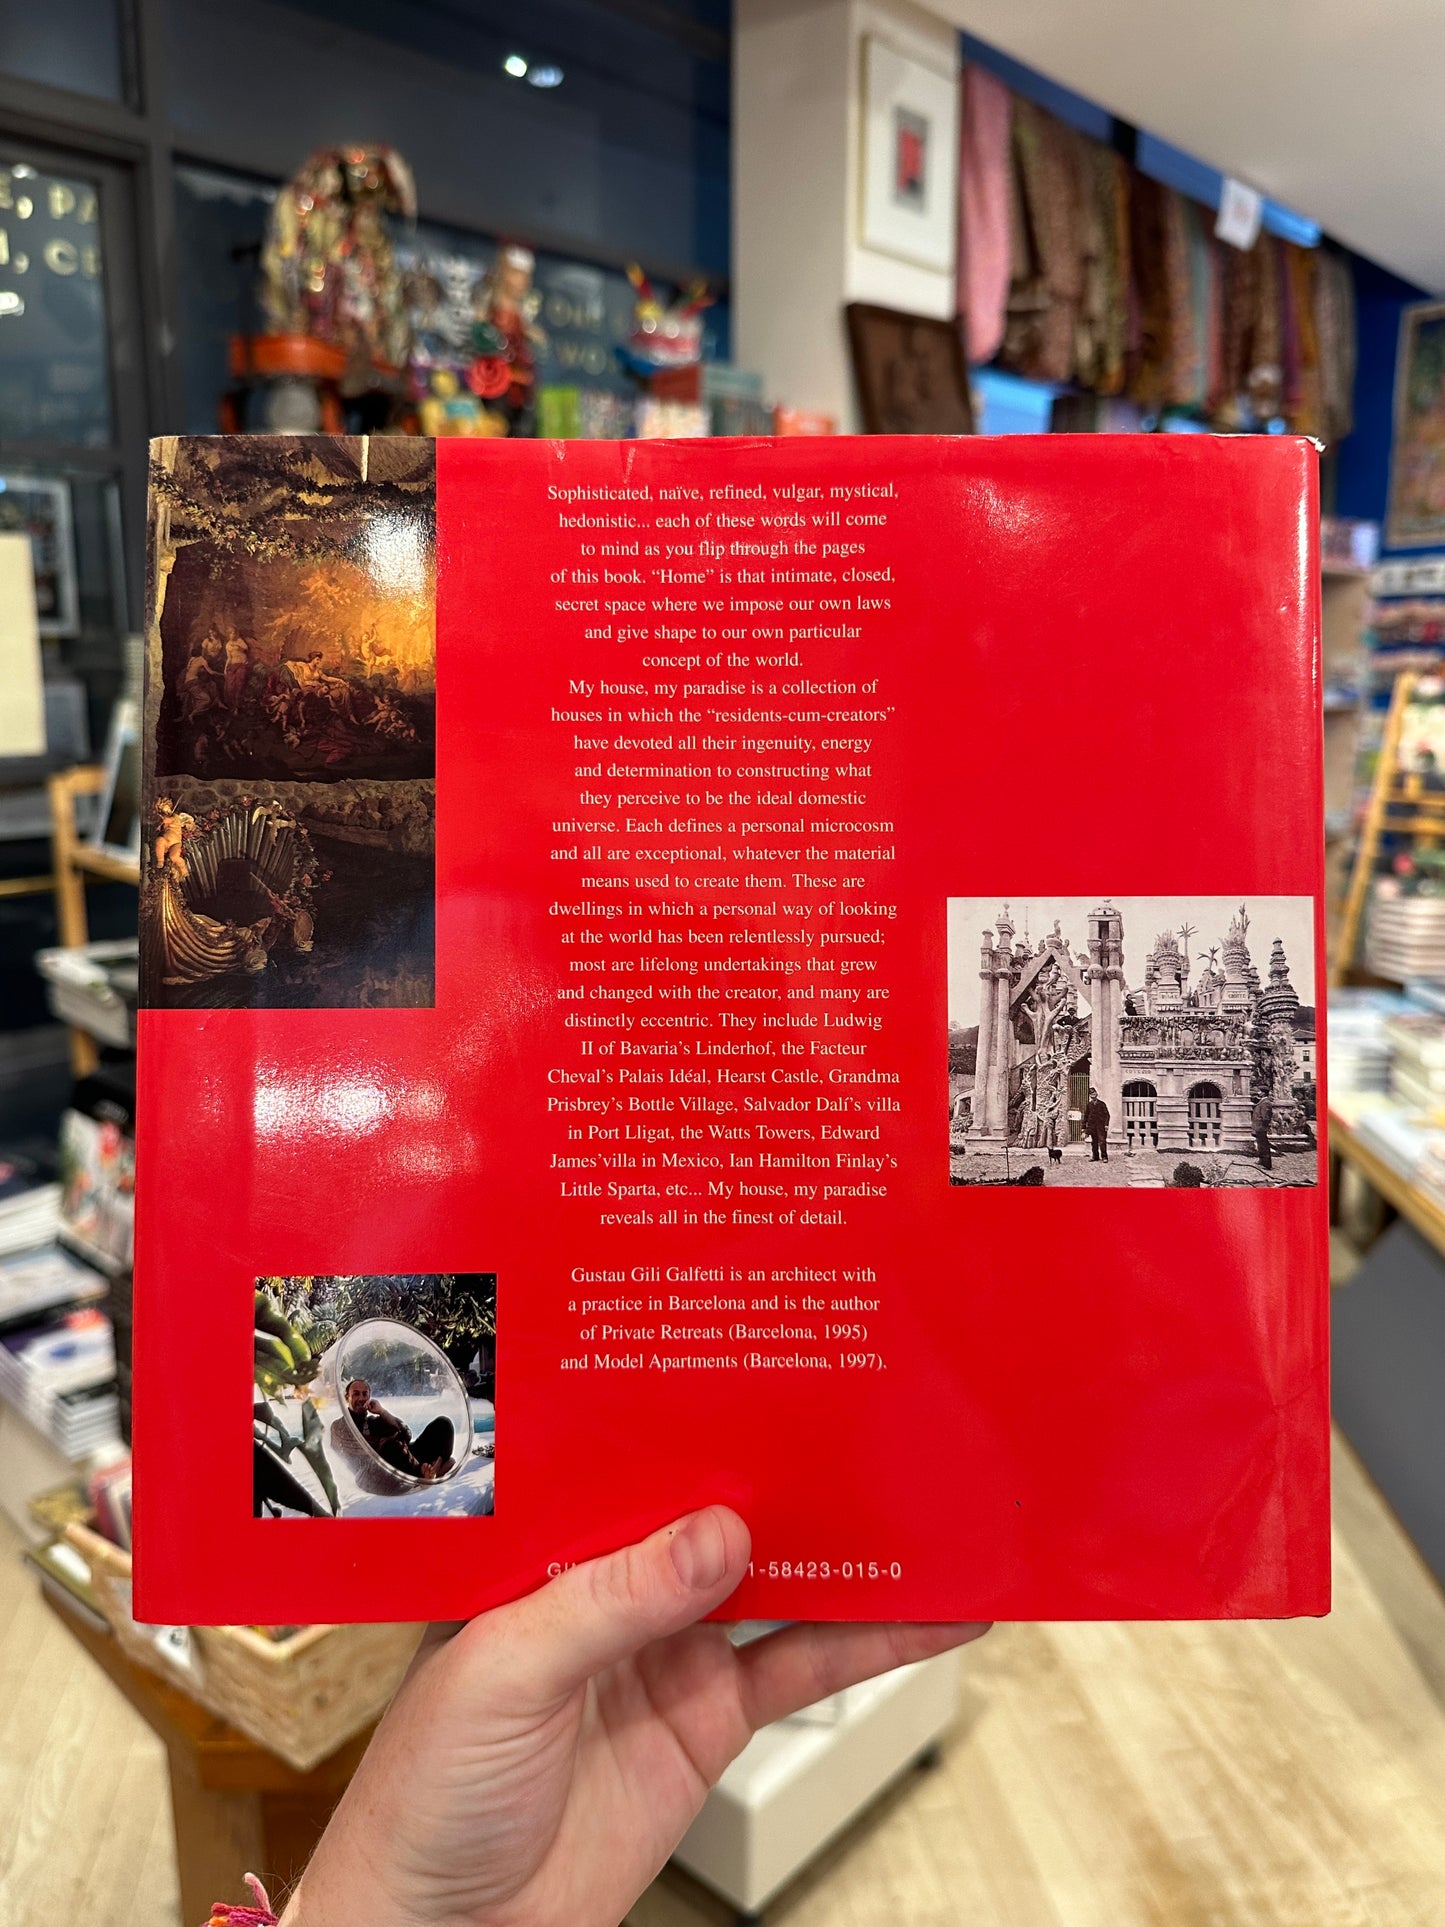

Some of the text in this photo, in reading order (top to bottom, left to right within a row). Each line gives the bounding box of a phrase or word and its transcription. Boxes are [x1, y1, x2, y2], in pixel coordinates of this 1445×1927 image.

[547, 481, 899, 503] Sophisticated, naïve, refined, vulgar, mystical,
[558, 510, 888, 529] hedonistic... each of these words will come
[549, 566, 896, 585] of this book. “Home” is that intimate, closed,
[554, 594, 892, 616] secret space where we impose our own laws
[641, 651, 804, 671] concept of the world.
[550, 706, 603, 722] houses
[607, 707, 623, 722] in
[627, 707, 674, 723] which
[678, 707, 702, 723] the
[573, 734, 873, 754] have devoted all their ingenuity, energy
[574, 762, 872, 782] and determination to constructing what
[552, 817, 895, 837] universe. Each defines a personal microcosm
[550, 845, 896, 865] and all are exceptional, whatever the material
[581, 873, 866, 888] means used to create them. These are
[560, 928, 886, 948] at the world has been relentlessly pursued;
[569, 956, 878, 976] most are lifelong undertakings that grew
[564, 1012, 883, 1032] distinctly eccentric. They include Ludwig
[580, 1040, 868, 1057] II of Bavaria’s Linderhof, the Facteur
[547, 1068, 901, 1086] Cheval’s Palais Idéal, Hearst Castle, Grandma
[547, 1096, 624, 1116] Prisbrey’s
[628, 1096, 675, 1112] Bottle
[678, 1096, 739, 1116] Village,
[743, 1096, 812, 1112] Salvador
[866, 1096, 901, 1112] villa
[567, 1124, 880, 1144] in Port Lligat, the Watts Towers, Edward
[641, 1152, 657, 1168] in
[661, 1152, 724, 1170] Mexico,
[729, 1152, 754, 1168] Ian
[758, 1152, 831, 1168] Hamilton
[835, 1153, 898, 1173] Finlay’s
[560, 1180, 888, 1201] Little Sparta, etc... My house, my paradise
[599, 1208, 847, 1225] reveals all in the finest of detail.
[570, 1265, 877, 1283] Gustau Gili Galfetti is an architect with
[579, 1323, 868, 1342] of Private Retreats (Barcelona, 1995)
[560, 1352, 887, 1373] and Model Apartments (Barcelona, 1997).
[747, 1561, 902, 1579] 1-58423-015-0
